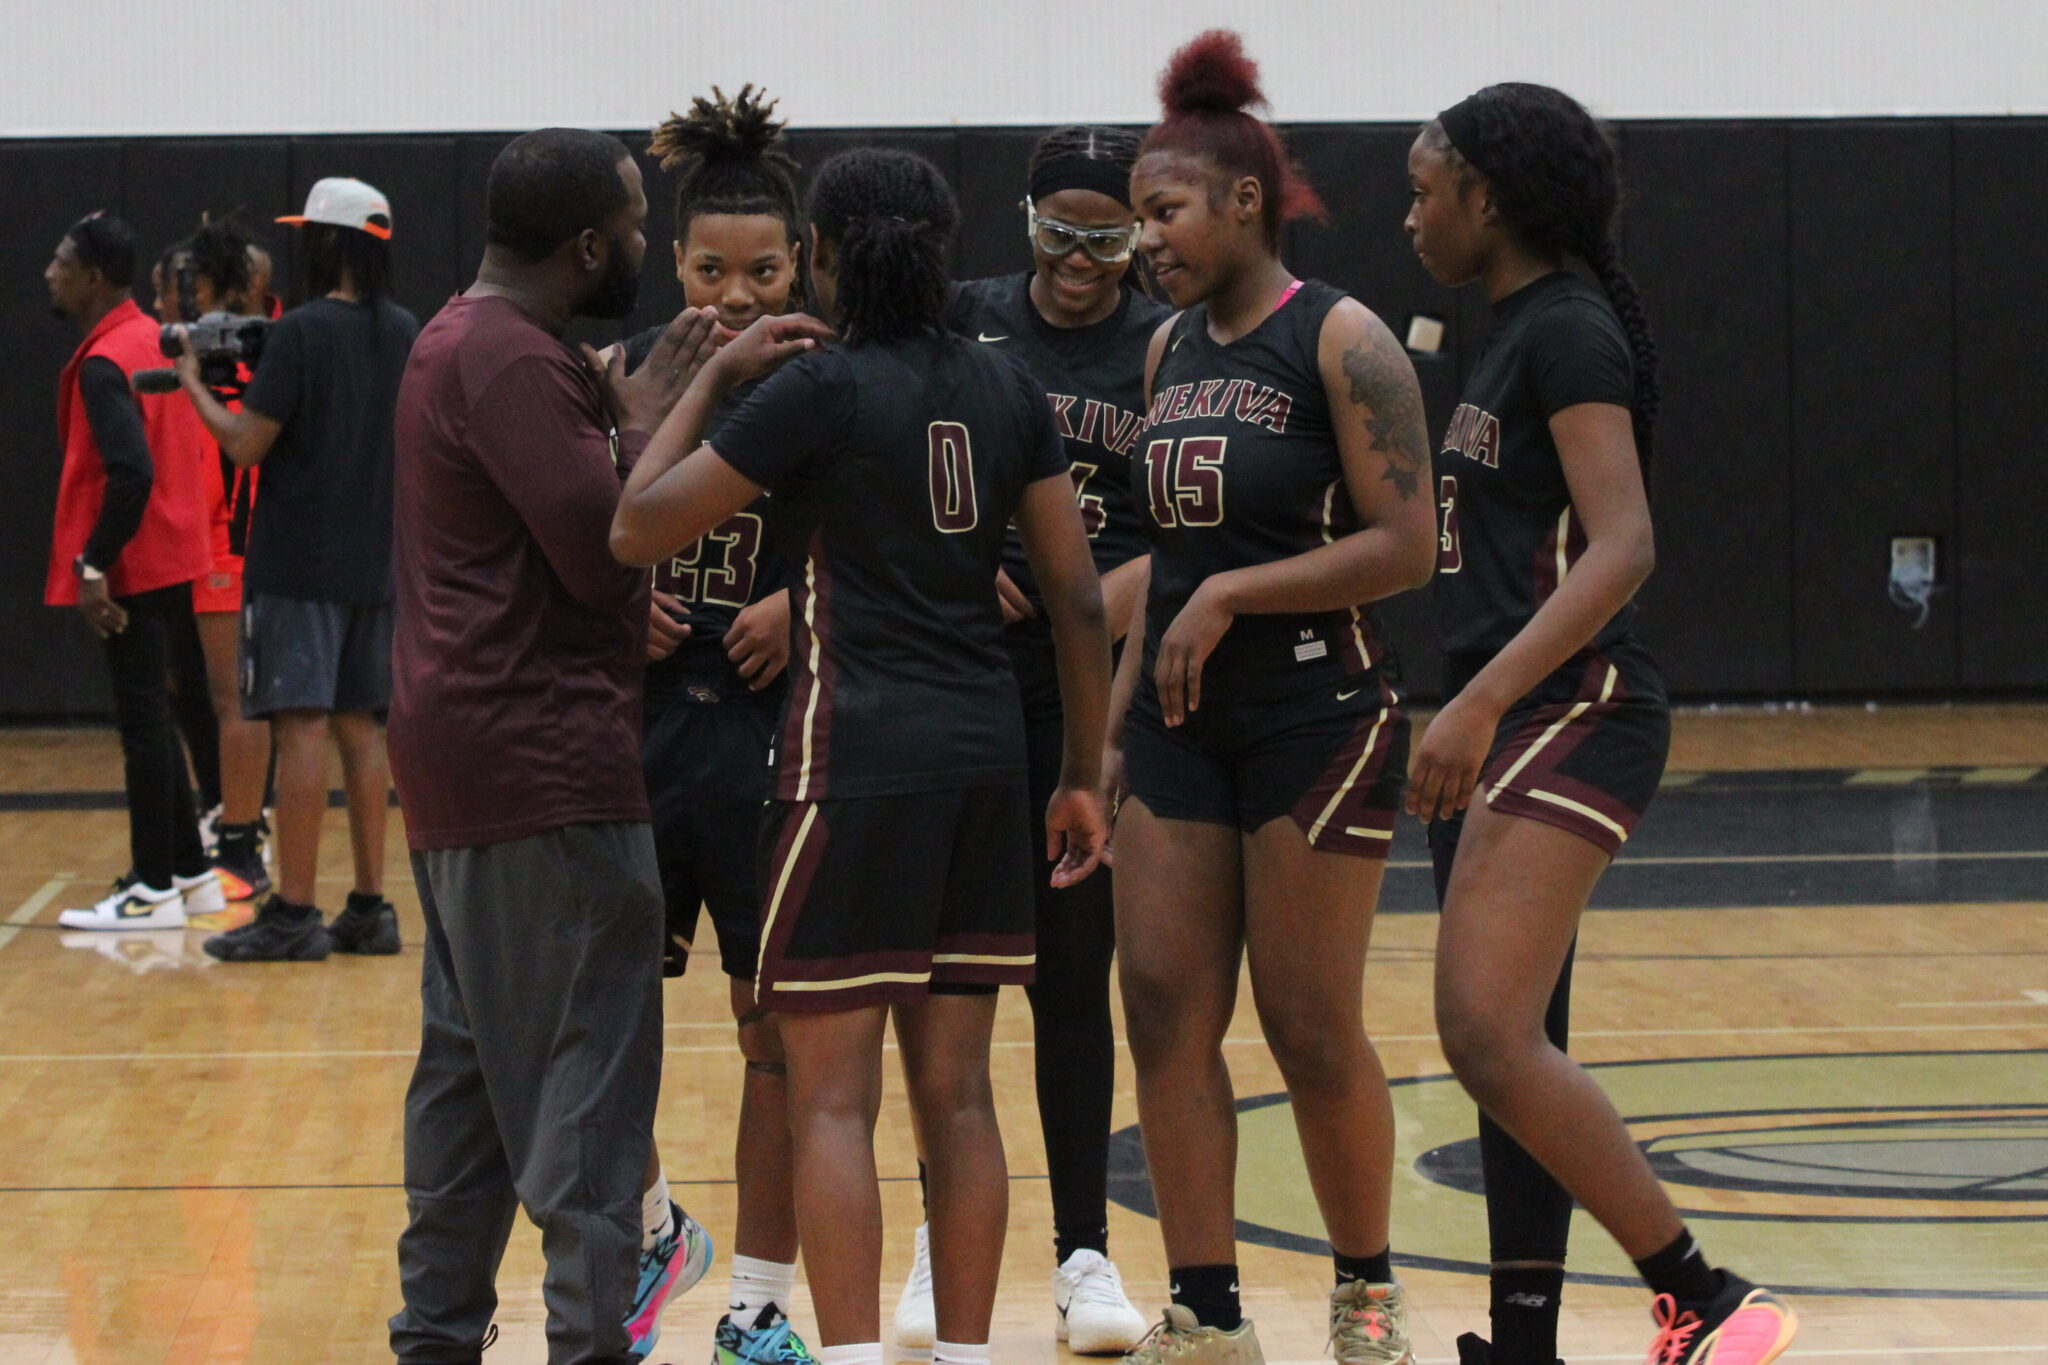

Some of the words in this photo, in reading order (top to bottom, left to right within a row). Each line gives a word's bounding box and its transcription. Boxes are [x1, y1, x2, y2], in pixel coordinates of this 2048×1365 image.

[1143, 379, 1293, 433] WEKIVA
[928, 421, 978, 533] 0
[1145, 436, 1228, 528] 15
[1440, 475, 1462, 573] 3
[651, 512, 763, 609] 23
[1300, 628, 1314, 641] M
